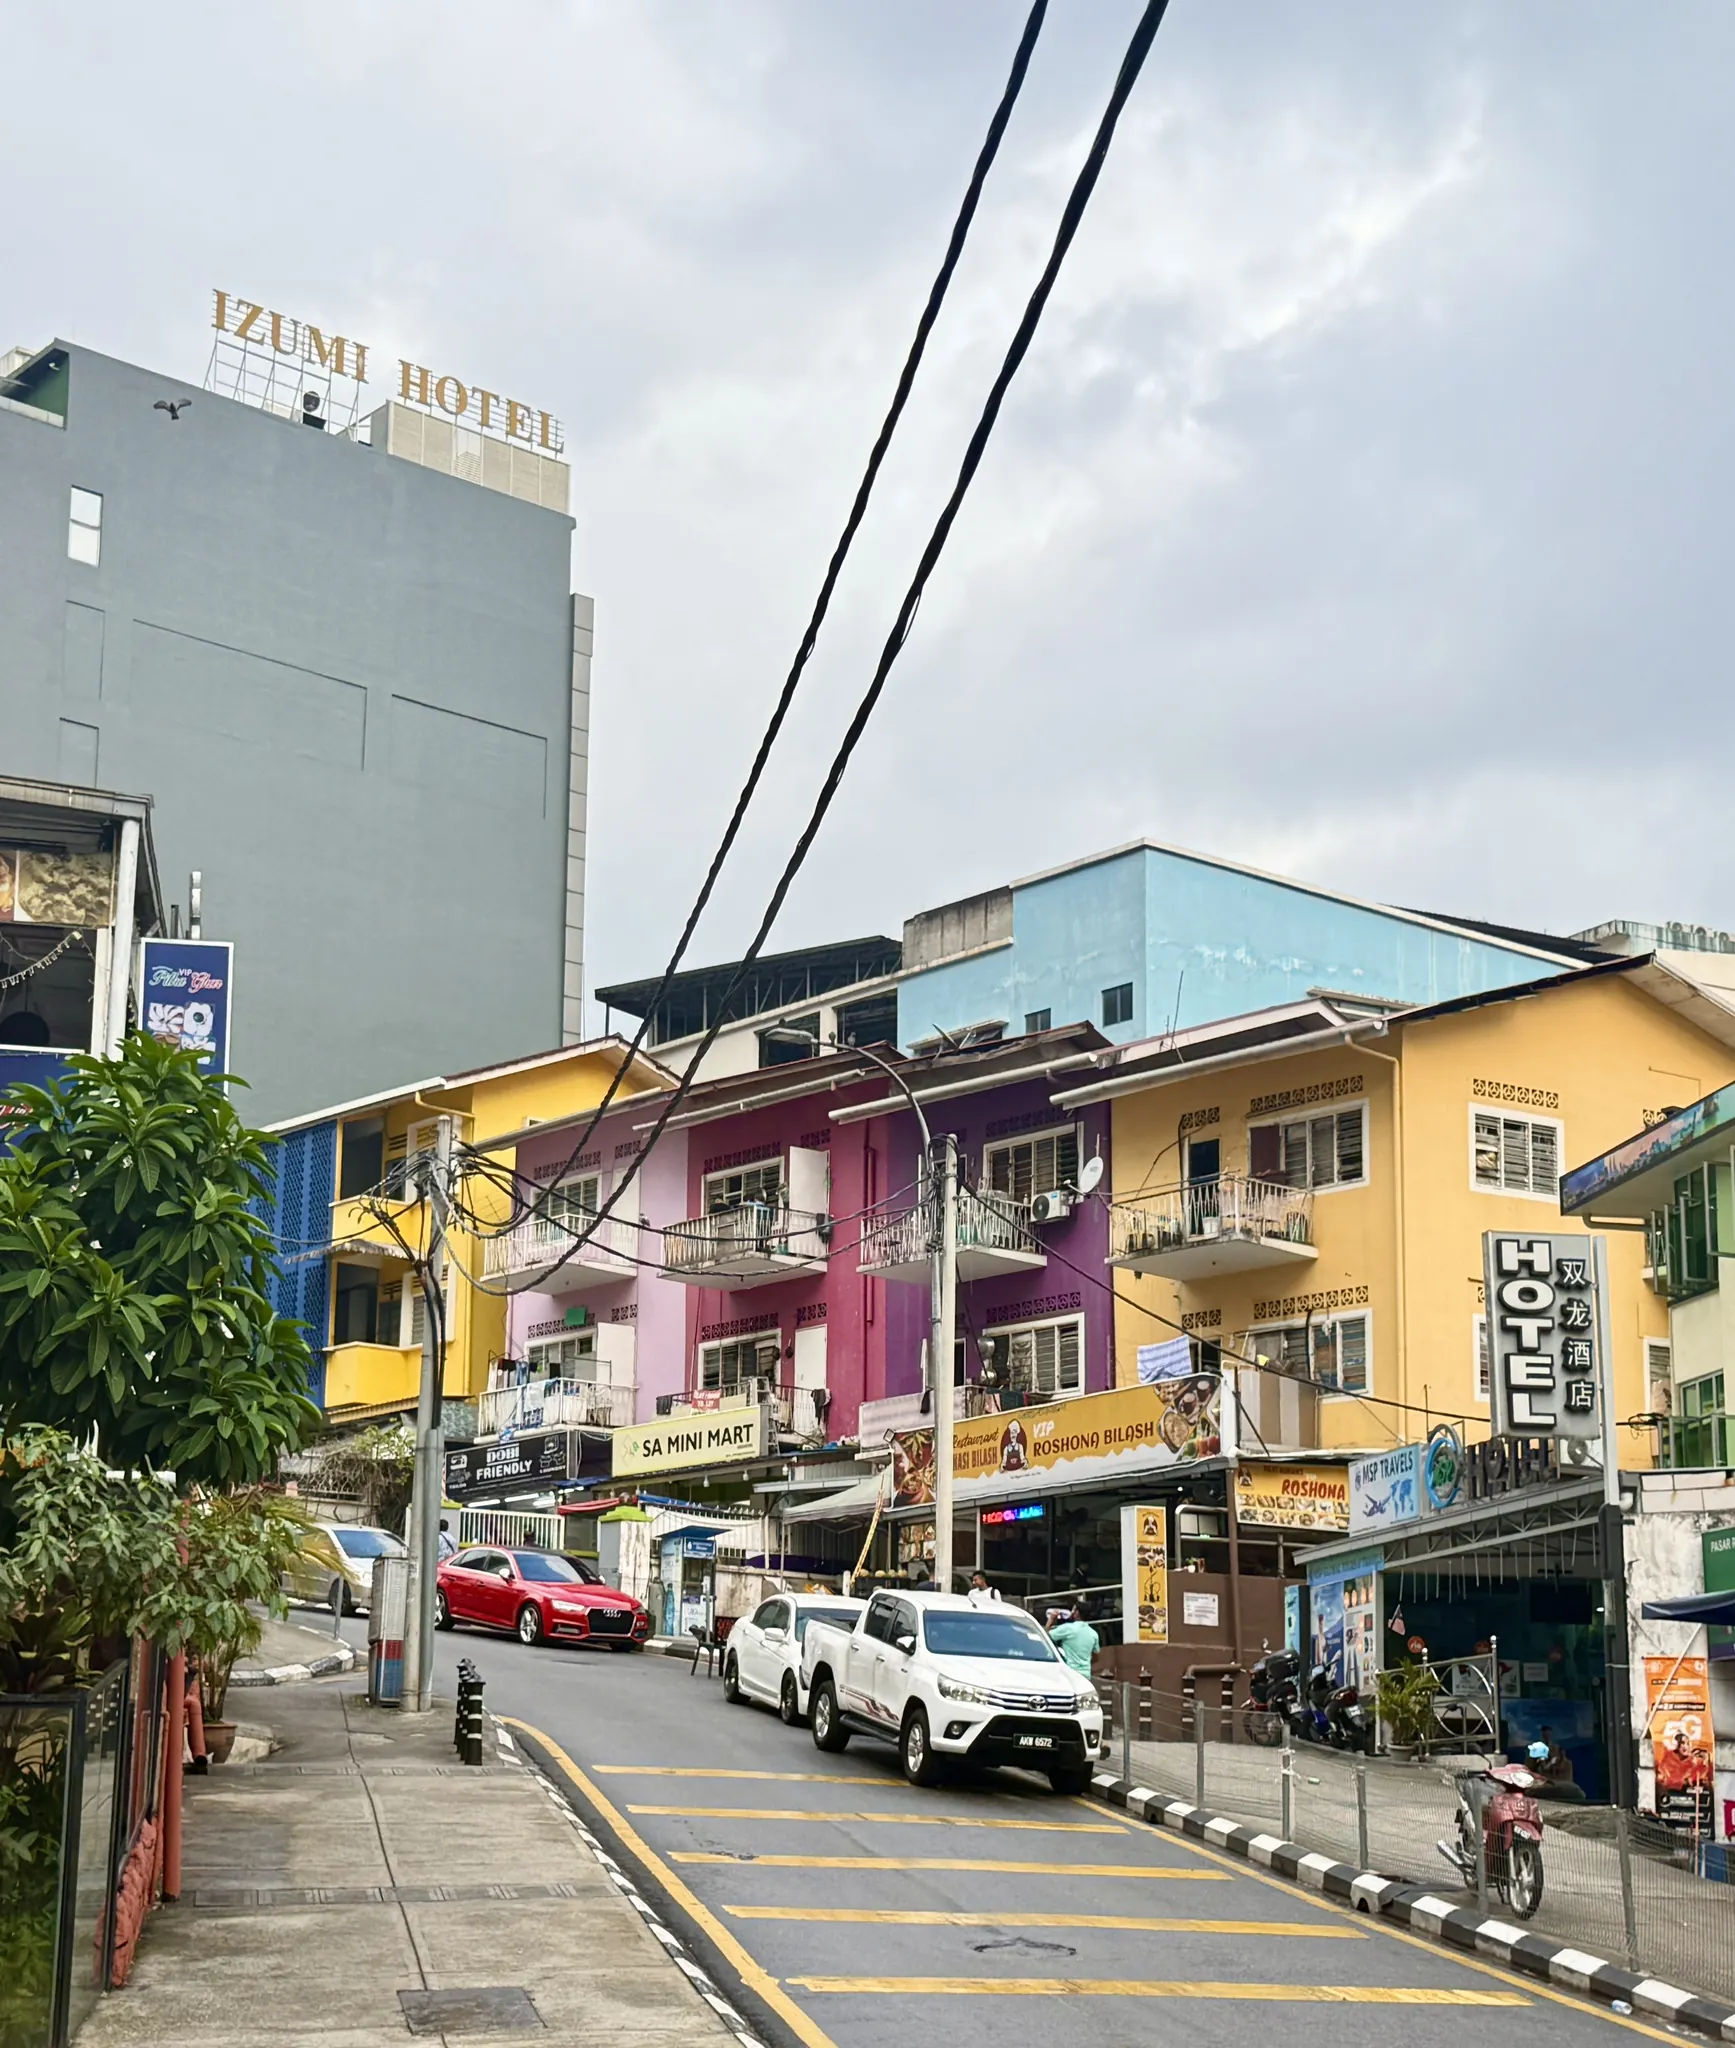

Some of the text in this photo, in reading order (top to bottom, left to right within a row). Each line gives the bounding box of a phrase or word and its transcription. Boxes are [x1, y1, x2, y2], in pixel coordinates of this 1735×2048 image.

[211, 288, 565, 454] IZUMI HOTEL
[1497, 1239, 1557, 1429] HOTEL
[1557, 1258, 1595, 1411] 双龙酒店
[643, 1424, 753, 1458] SA MINI MART
[1032, 1420, 1055, 1438] VIP
[1033, 1421, 1154, 1457] ROSHONA BILASH
[476, 1460, 533, 1481] FRIENDLY
[486, 1446, 520, 1463] DOBI
[972, 1446, 998, 1468] BILASH
[1362, 1463, 1378, 1484] MSP
[1380, 1450, 1413, 1479] TRAVELS
[1281, 1479, 1345, 1501] ROSHONA
[1710, 1537, 1731, 1553] PASAR
[1663, 1714, 1703, 1751] 5G
